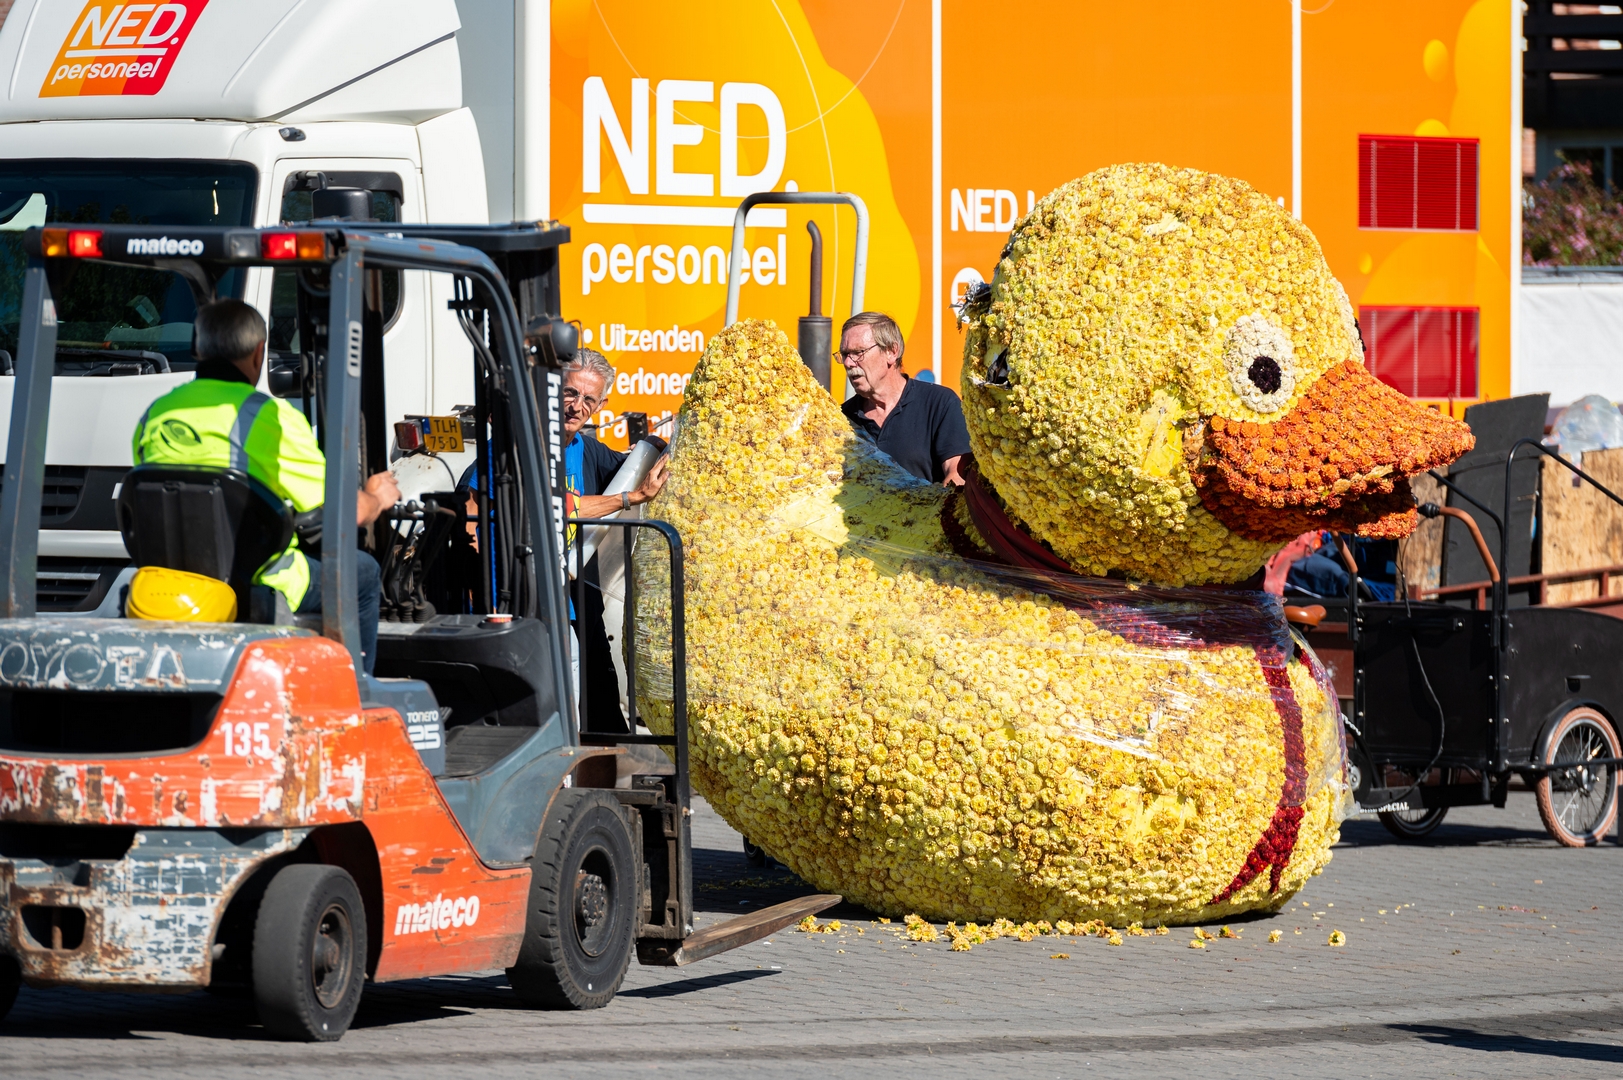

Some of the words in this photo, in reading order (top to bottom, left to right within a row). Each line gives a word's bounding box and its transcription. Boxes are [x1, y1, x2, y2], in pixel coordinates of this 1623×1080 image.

[69, 3, 187, 47] NED.
[50, 57, 163, 85] personeel
[582, 76, 799, 198] NED.
[950, 188, 1018, 232] NED
[126, 235, 204, 255] mateco
[600, 323, 704, 352] Uitzenden
[434, 419, 457, 433] TLH
[220, 722, 272, 756] 135
[407, 723, 441, 750] 25
[394, 893, 480, 935] mateco
